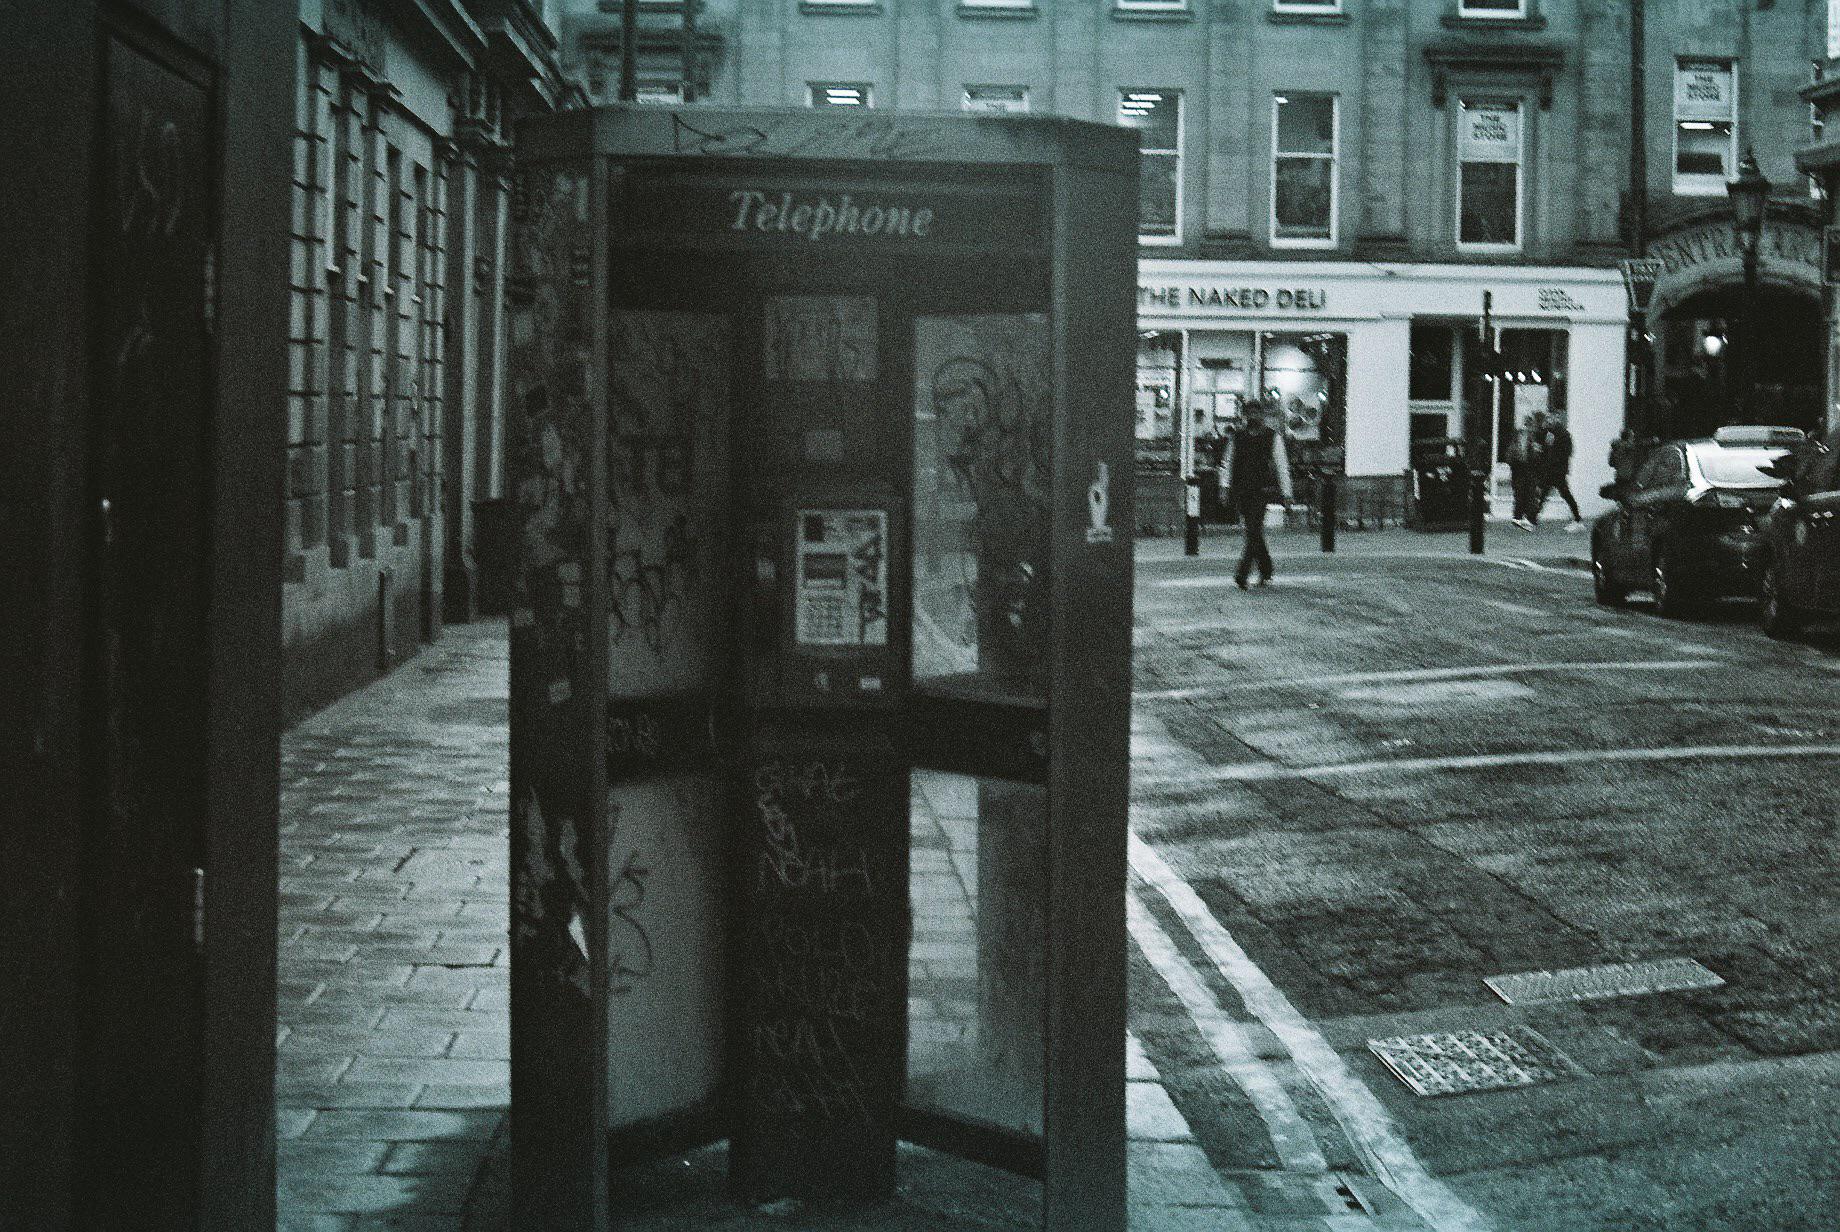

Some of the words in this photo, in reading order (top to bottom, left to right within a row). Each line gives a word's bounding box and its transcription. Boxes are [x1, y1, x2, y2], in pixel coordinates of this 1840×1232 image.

[729, 190, 935, 241] Telephone
[1137, 287, 1178, 310] THE
[1186, 287, 1266, 310] NAKED
[1273, 288, 1324, 311] DELI
